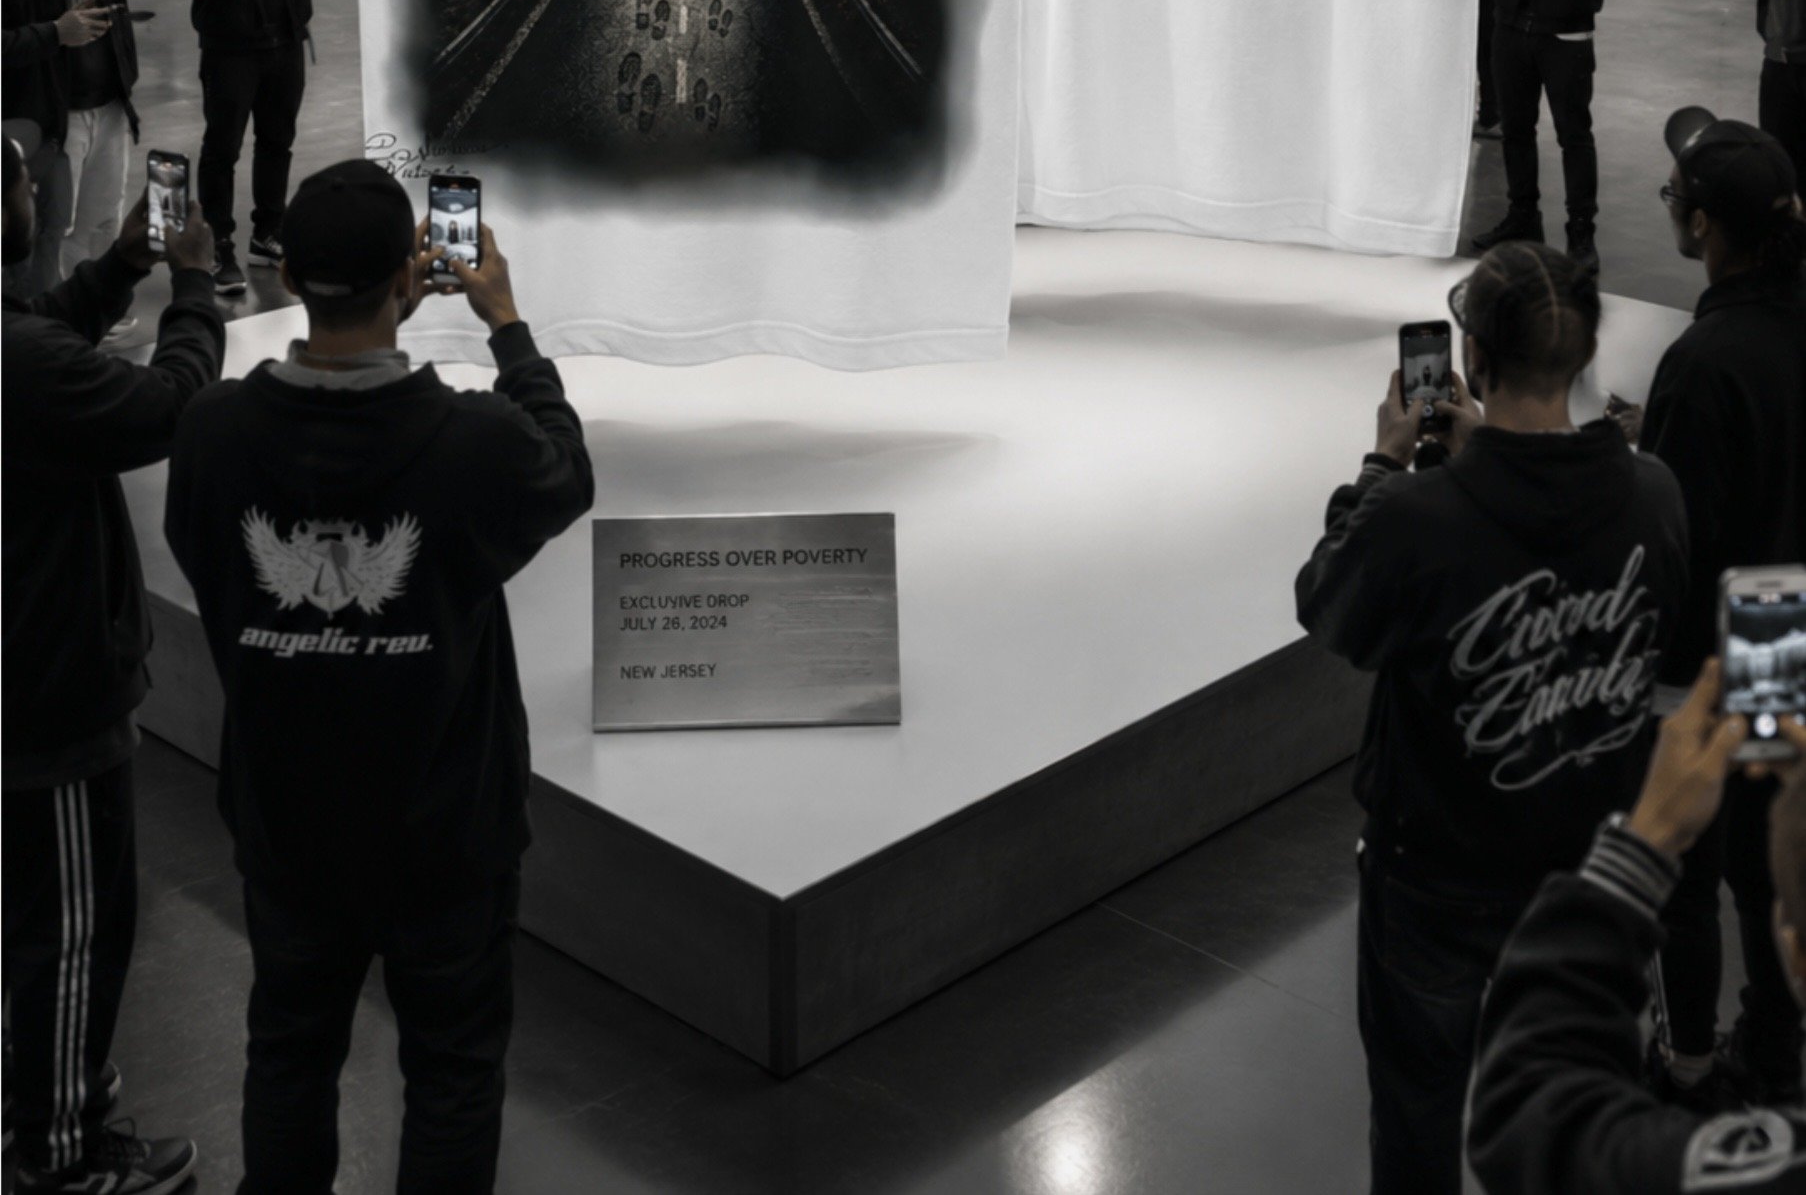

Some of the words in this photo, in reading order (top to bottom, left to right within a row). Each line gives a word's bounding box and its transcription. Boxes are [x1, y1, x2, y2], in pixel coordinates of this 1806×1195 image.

[620, 551, 720, 569] PROGRESS
[725, 549, 777, 567] OVER
[782, 548, 868, 566] POVERTY
[619, 617, 657, 631] JULY
[689, 615, 727, 630] 2024
[238, 627, 361, 658] angelic
[620, 665, 657, 680] NEW
[660, 663, 717, 679] JERSEY
